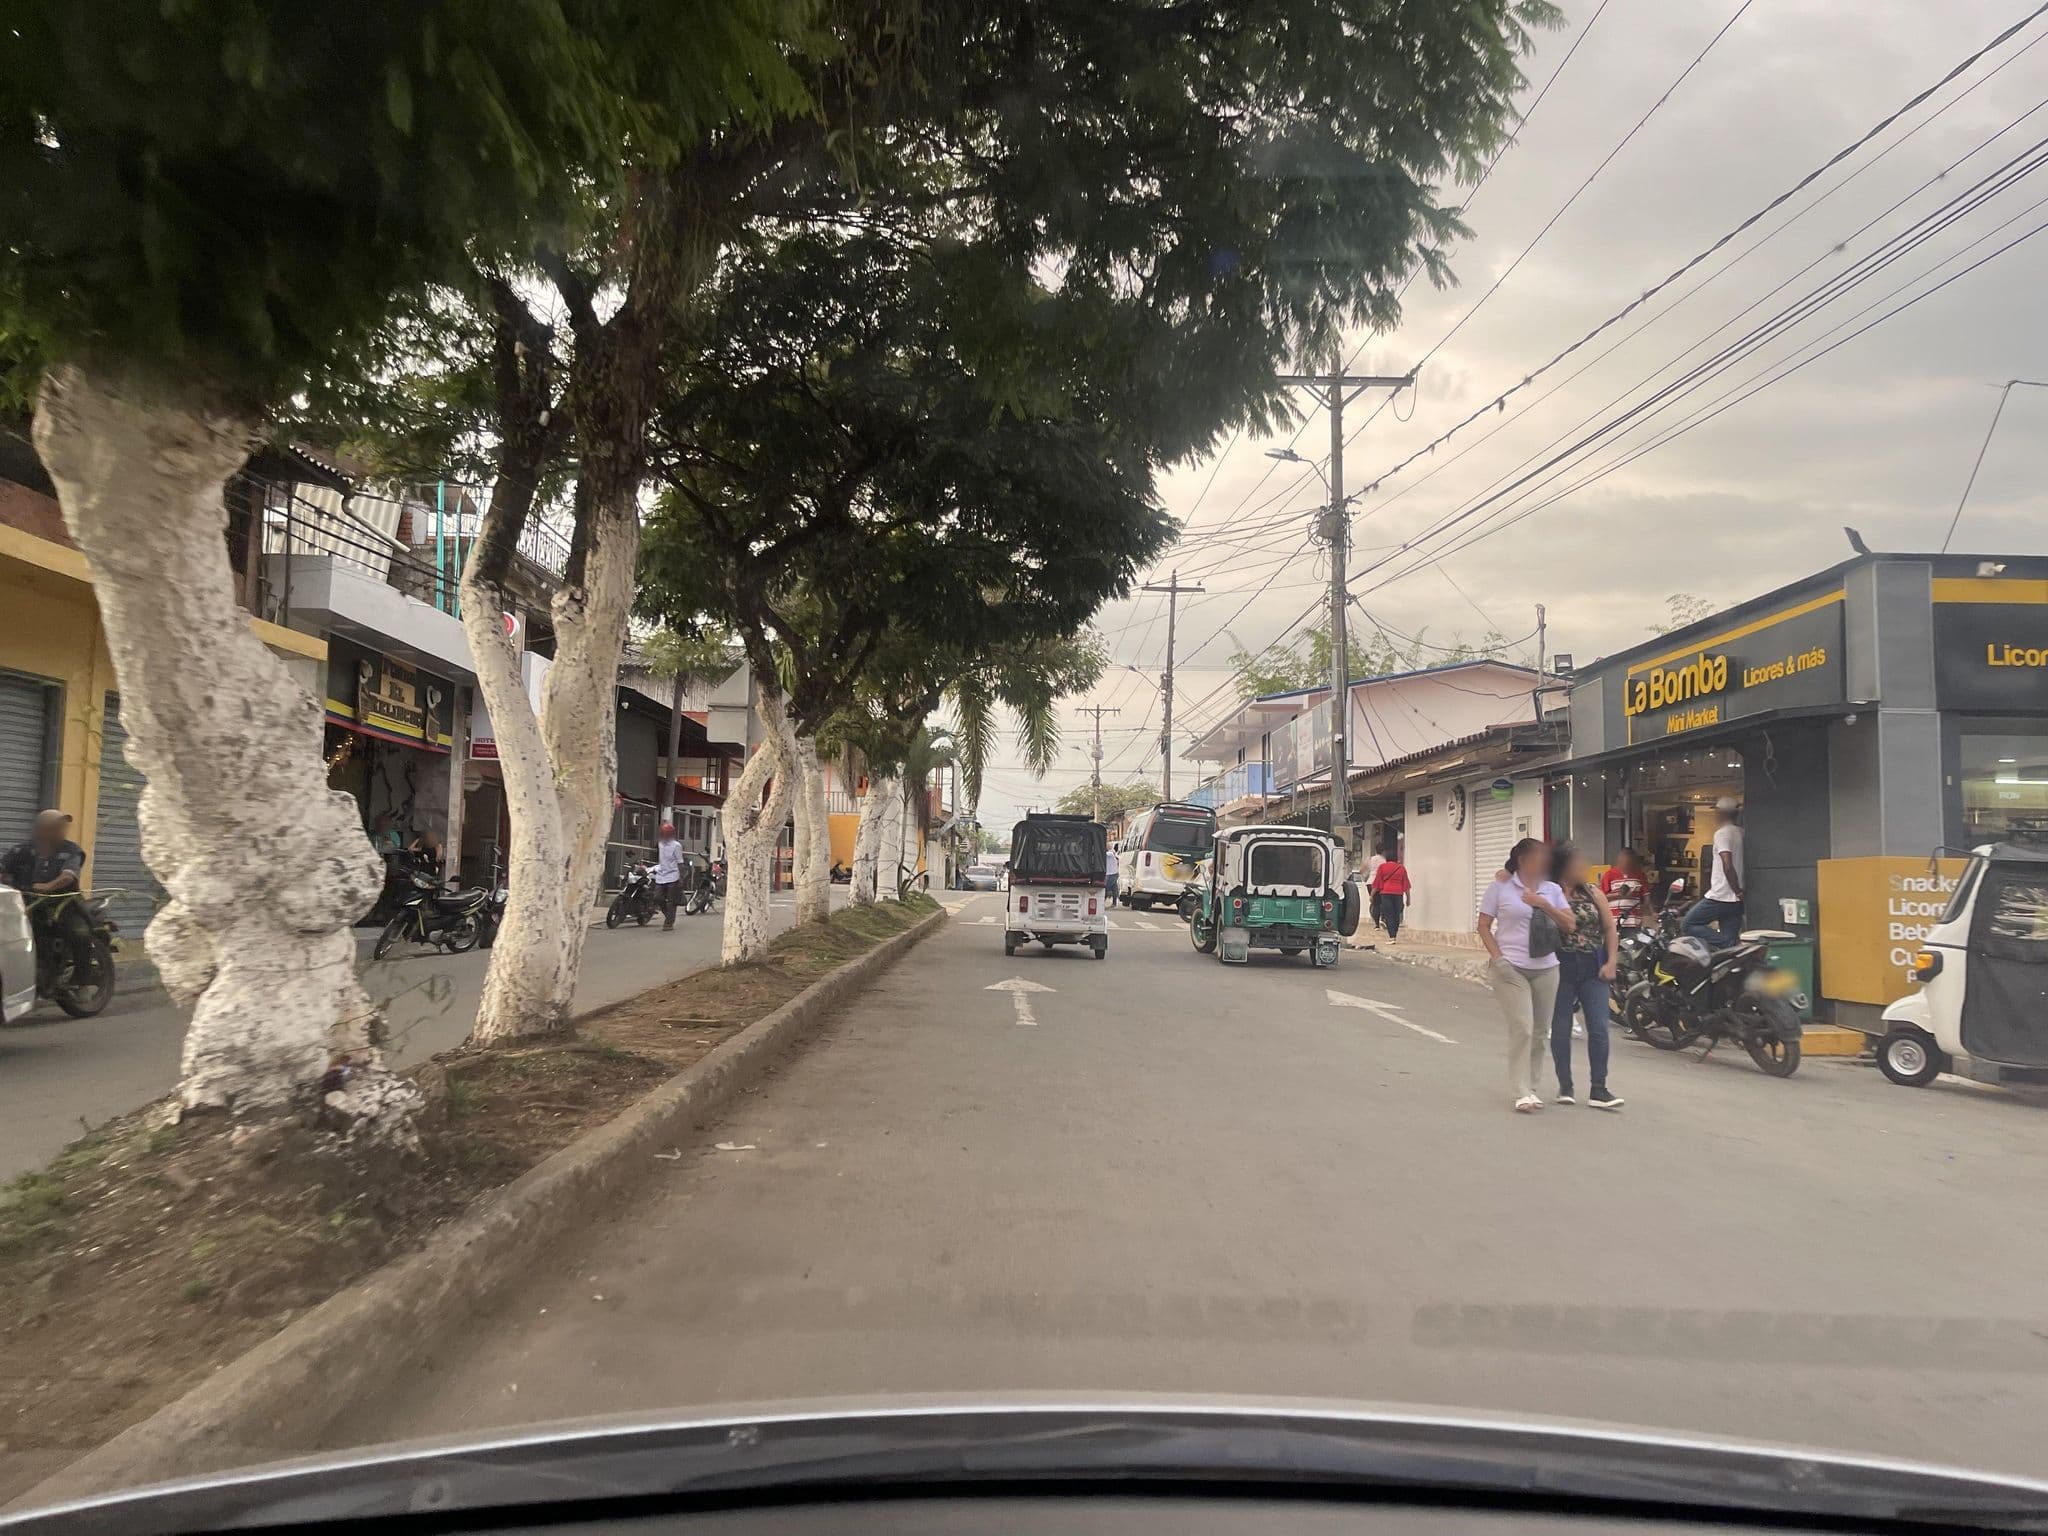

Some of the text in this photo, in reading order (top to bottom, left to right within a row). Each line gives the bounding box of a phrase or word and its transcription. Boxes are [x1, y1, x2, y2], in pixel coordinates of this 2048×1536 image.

[1624, 652, 1728, 716] La Bomba
[1743, 646, 1826, 688] Licores & más
[1666, 705, 1719, 734] Mini Market
